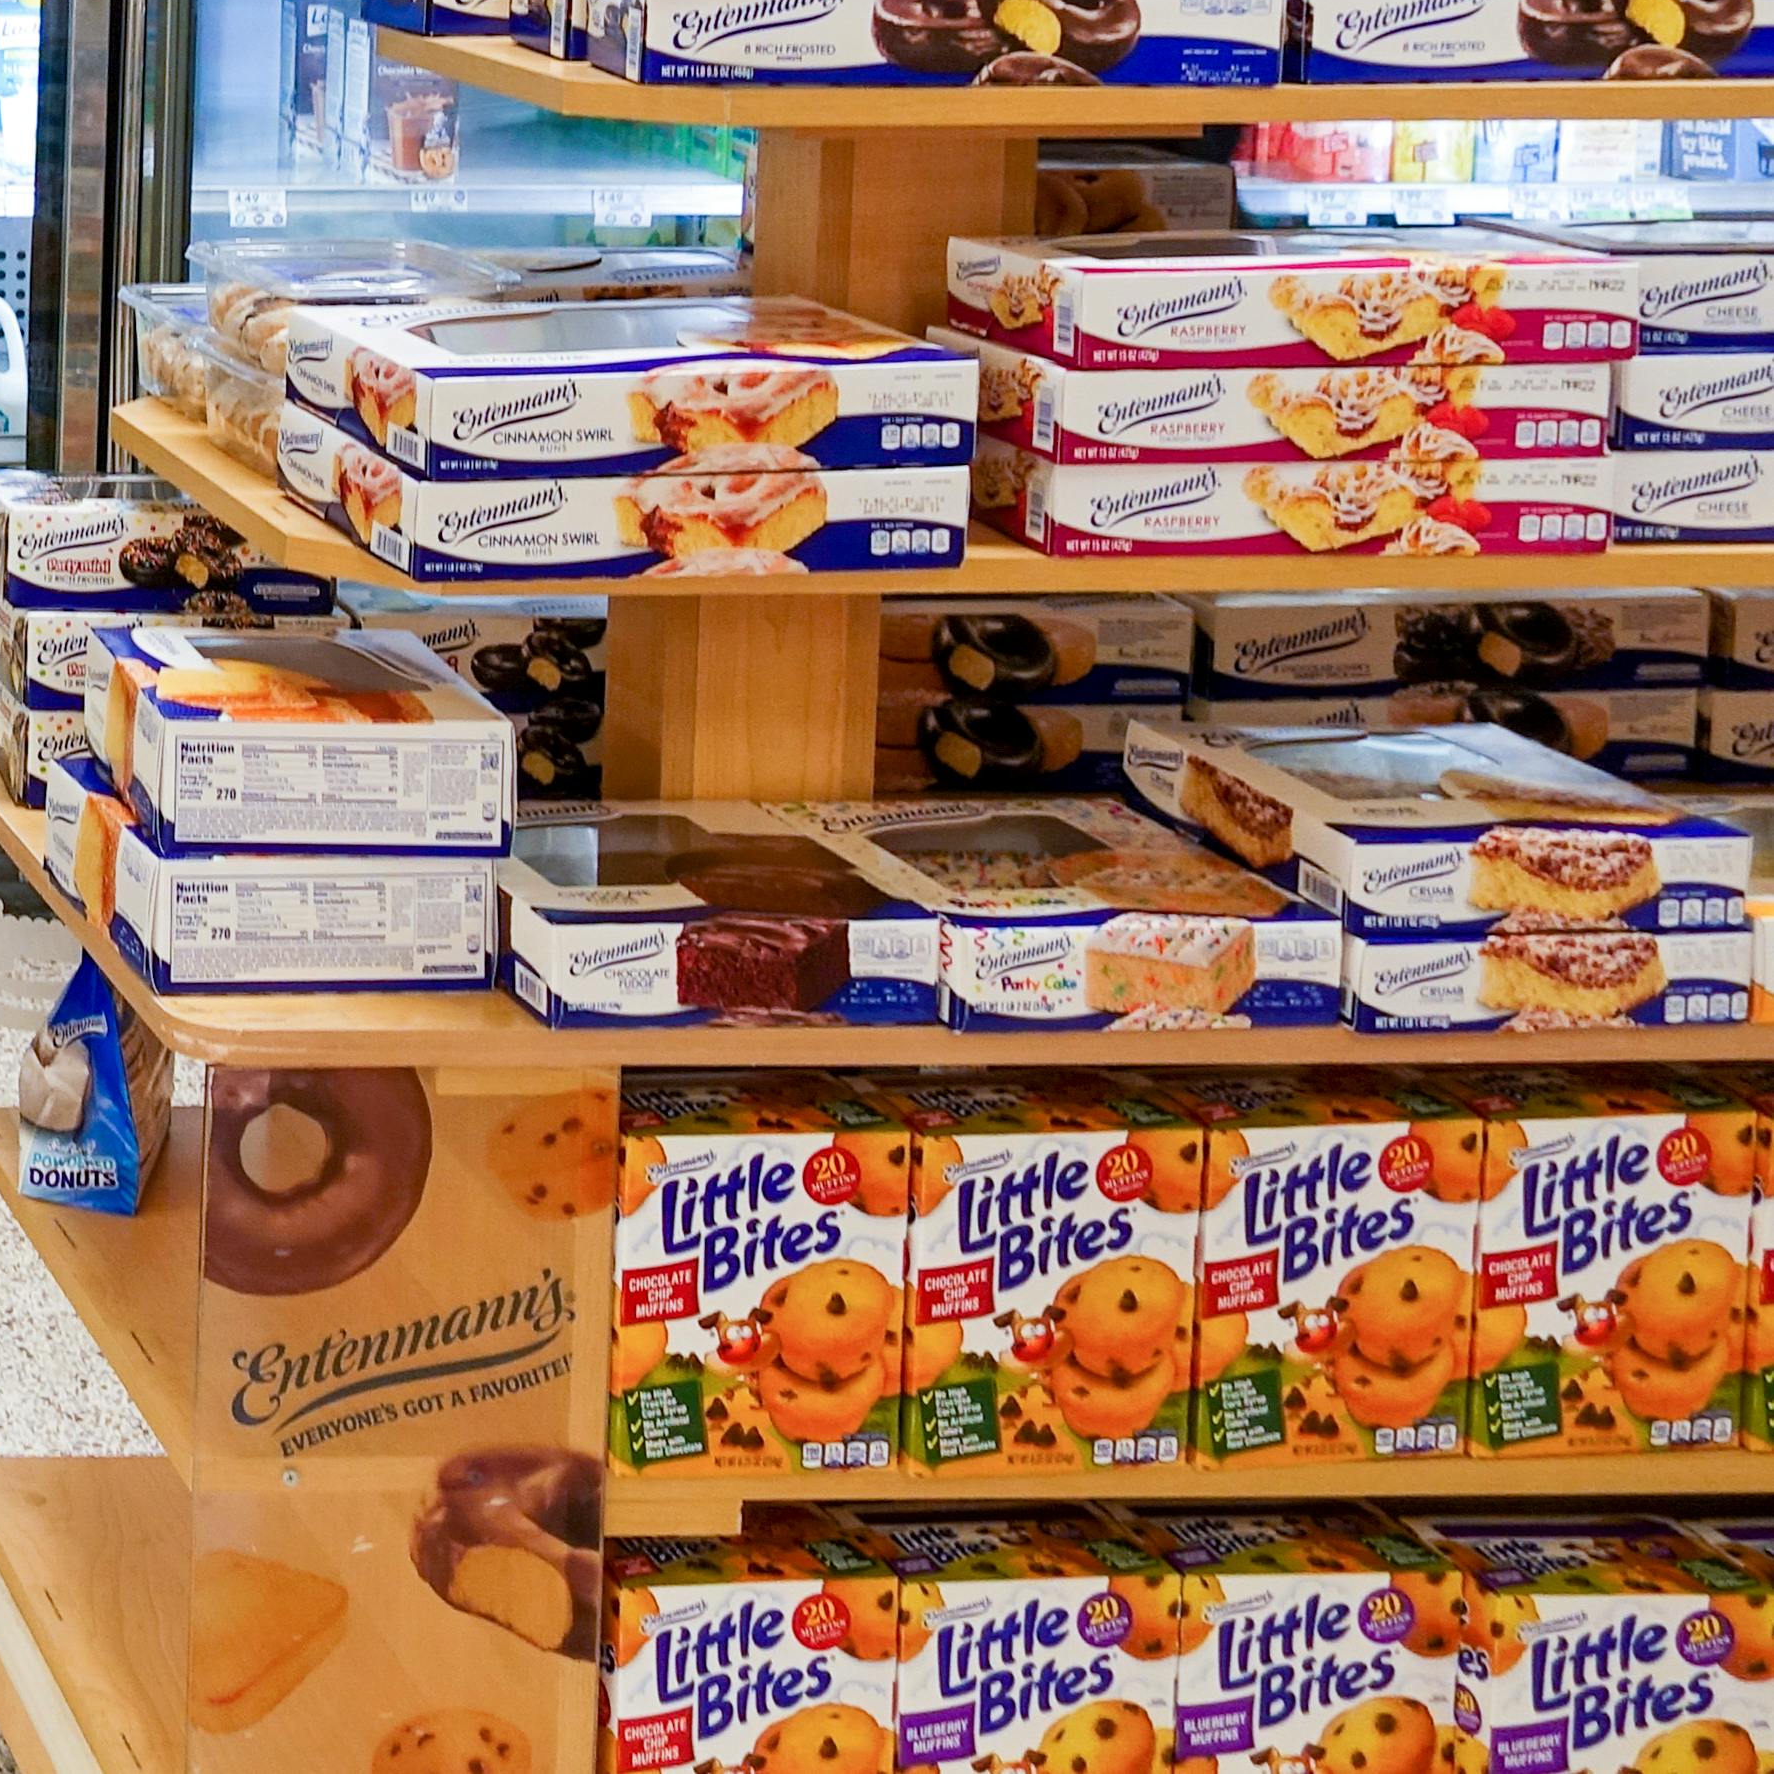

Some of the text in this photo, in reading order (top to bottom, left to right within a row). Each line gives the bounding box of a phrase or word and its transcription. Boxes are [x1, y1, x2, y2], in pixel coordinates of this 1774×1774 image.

[755, 45, 781, 55] RICH
[786, 44, 836, 55] FROSTED
[1640, 259, 1772, 317] Entenmann's
[1117, 276, 1247, 337] Entenmann's
[1706, 306, 1758, 318] CHEESE
[1170, 326, 1247, 336] RASPBERRY
[452, 379, 582, 442] Entenmann's
[1098, 374, 1226, 436] Entenmann's
[1722, 406, 1771, 417] CHEESE
[493, 428, 614, 444] CINNAMON SWIRL
[1150, 423, 1226, 435] RASPBERRY
[1632, 455, 1763, 513] Entenmann's
[1091, 467, 1222, 528] Entenmann's
[1697, 501, 1749, 513] CHEESE
[438, 480, 568, 545] Entenmann's
[1144, 515, 1220, 527] RASPBERRY
[18, 514, 128, 560] Entenmann's
[478, 531, 600, 547] CINNAMON SWIRL
[1234, 608, 1371, 674] Entenmann's
[181, 742, 235, 754] Nutrition
[181, 755, 213, 765] Facts
[216, 788, 236, 800] 270
[1363, 847, 1464, 893] Entenmann's
[176, 882, 229, 895] Nutrition
[176, 894, 209, 906] Facts
[1409, 886, 1454, 896] CRUMB
[211, 927, 231, 941] 270
[569, 929, 669, 977] Entenmann's
[975, 932, 1075, 980] Entenmann's
[604, 968, 671, 981] CHOCOLATE
[618, 977, 655, 988] FUDGE
[1375, 947, 1473, 995] Entenmann's
[1001, 975, 1077, 993] Party Cake
[1420, 986, 1464, 996] CRUMB
[1388, 1143, 1421, 1166] 20
[1666, 1134, 1699, 1160] 20
[812, 1153, 845, 1179] 20
[1106, 1152, 1140, 1177] 20
[29, 1167, 119, 1190] DONUTS
[1522, 1135, 1649, 1239] Little
[661, 1153, 795, 1256] Little
[958, 1152, 1088, 1254] Little
[1243, 1145, 1371, 1246] Little
[1283, 1198, 1414, 1284] Bites
[1562, 1192, 1693, 1276] Bites
[703, 1212, 840, 1293] Bites
[998, 1209, 1133, 1292] Bites
[1210, 1262, 1273, 1286] CHOCOLATE
[1488, 1254, 1552, 1277] CHOCOLATE
[628, 1268, 692, 1293] CHOCOLATE
[924, 1269, 989, 1293] CHOCOLATE
[1229, 1279, 1255, 1296] CHIP
[1495, 1281, 1545, 1301] MUFFINS
[1506, 1271, 1533, 1287] CHIP
[647, 1287, 674, 1303] CHIP
[943, 1286, 969, 1303] CHIP
[1217, 1290, 1265, 1311] MUFFINS
[635, 1299, 684, 1318] MUFFINS
[931, 1298, 980, 1318] MUFFINS
[231, 1267, 576, 1428] Entenmann's
[280, 1351, 572, 1458] EVERYONE'S GOT A FAVORITE!
[801, 1601, 835, 1627] 20
[1086, 1600, 1120, 1624] 20
[1367, 1594, 1402, 1619] 20
[1685, 1617, 1721, 1641] 20
[655, 1601, 785, 1705] Little
[938, 1600, 1068, 1702] Little
[1218, 1594, 1350, 1692] Little
[1532, 1616, 1666, 1714] Little
[697, 1656, 832, 1740] Bites
[979, 1654, 1115, 1737] Bites
[1258, 1649, 1396, 1730] Bites
[1183, 1712, 1248, 1733] BLUEBERRY
[1572, 1673, 1714, 1752] Bites
[623, 1718, 688, 1743] CHOCOLATE
[905, 1718, 969, 1743] BLUEBERRY
[1190, 1729, 1240, 1747] MUFFINS
[631, 1747, 680, 1765] MUFFINS
[642, 1737, 669, 1752] CHIP
[913, 1734, 961, 1755] MUFFINS
[1497, 1735, 1563, 1758] BLUEBERRY
[1504, 1749, 1553, 1769] MUFFINS
